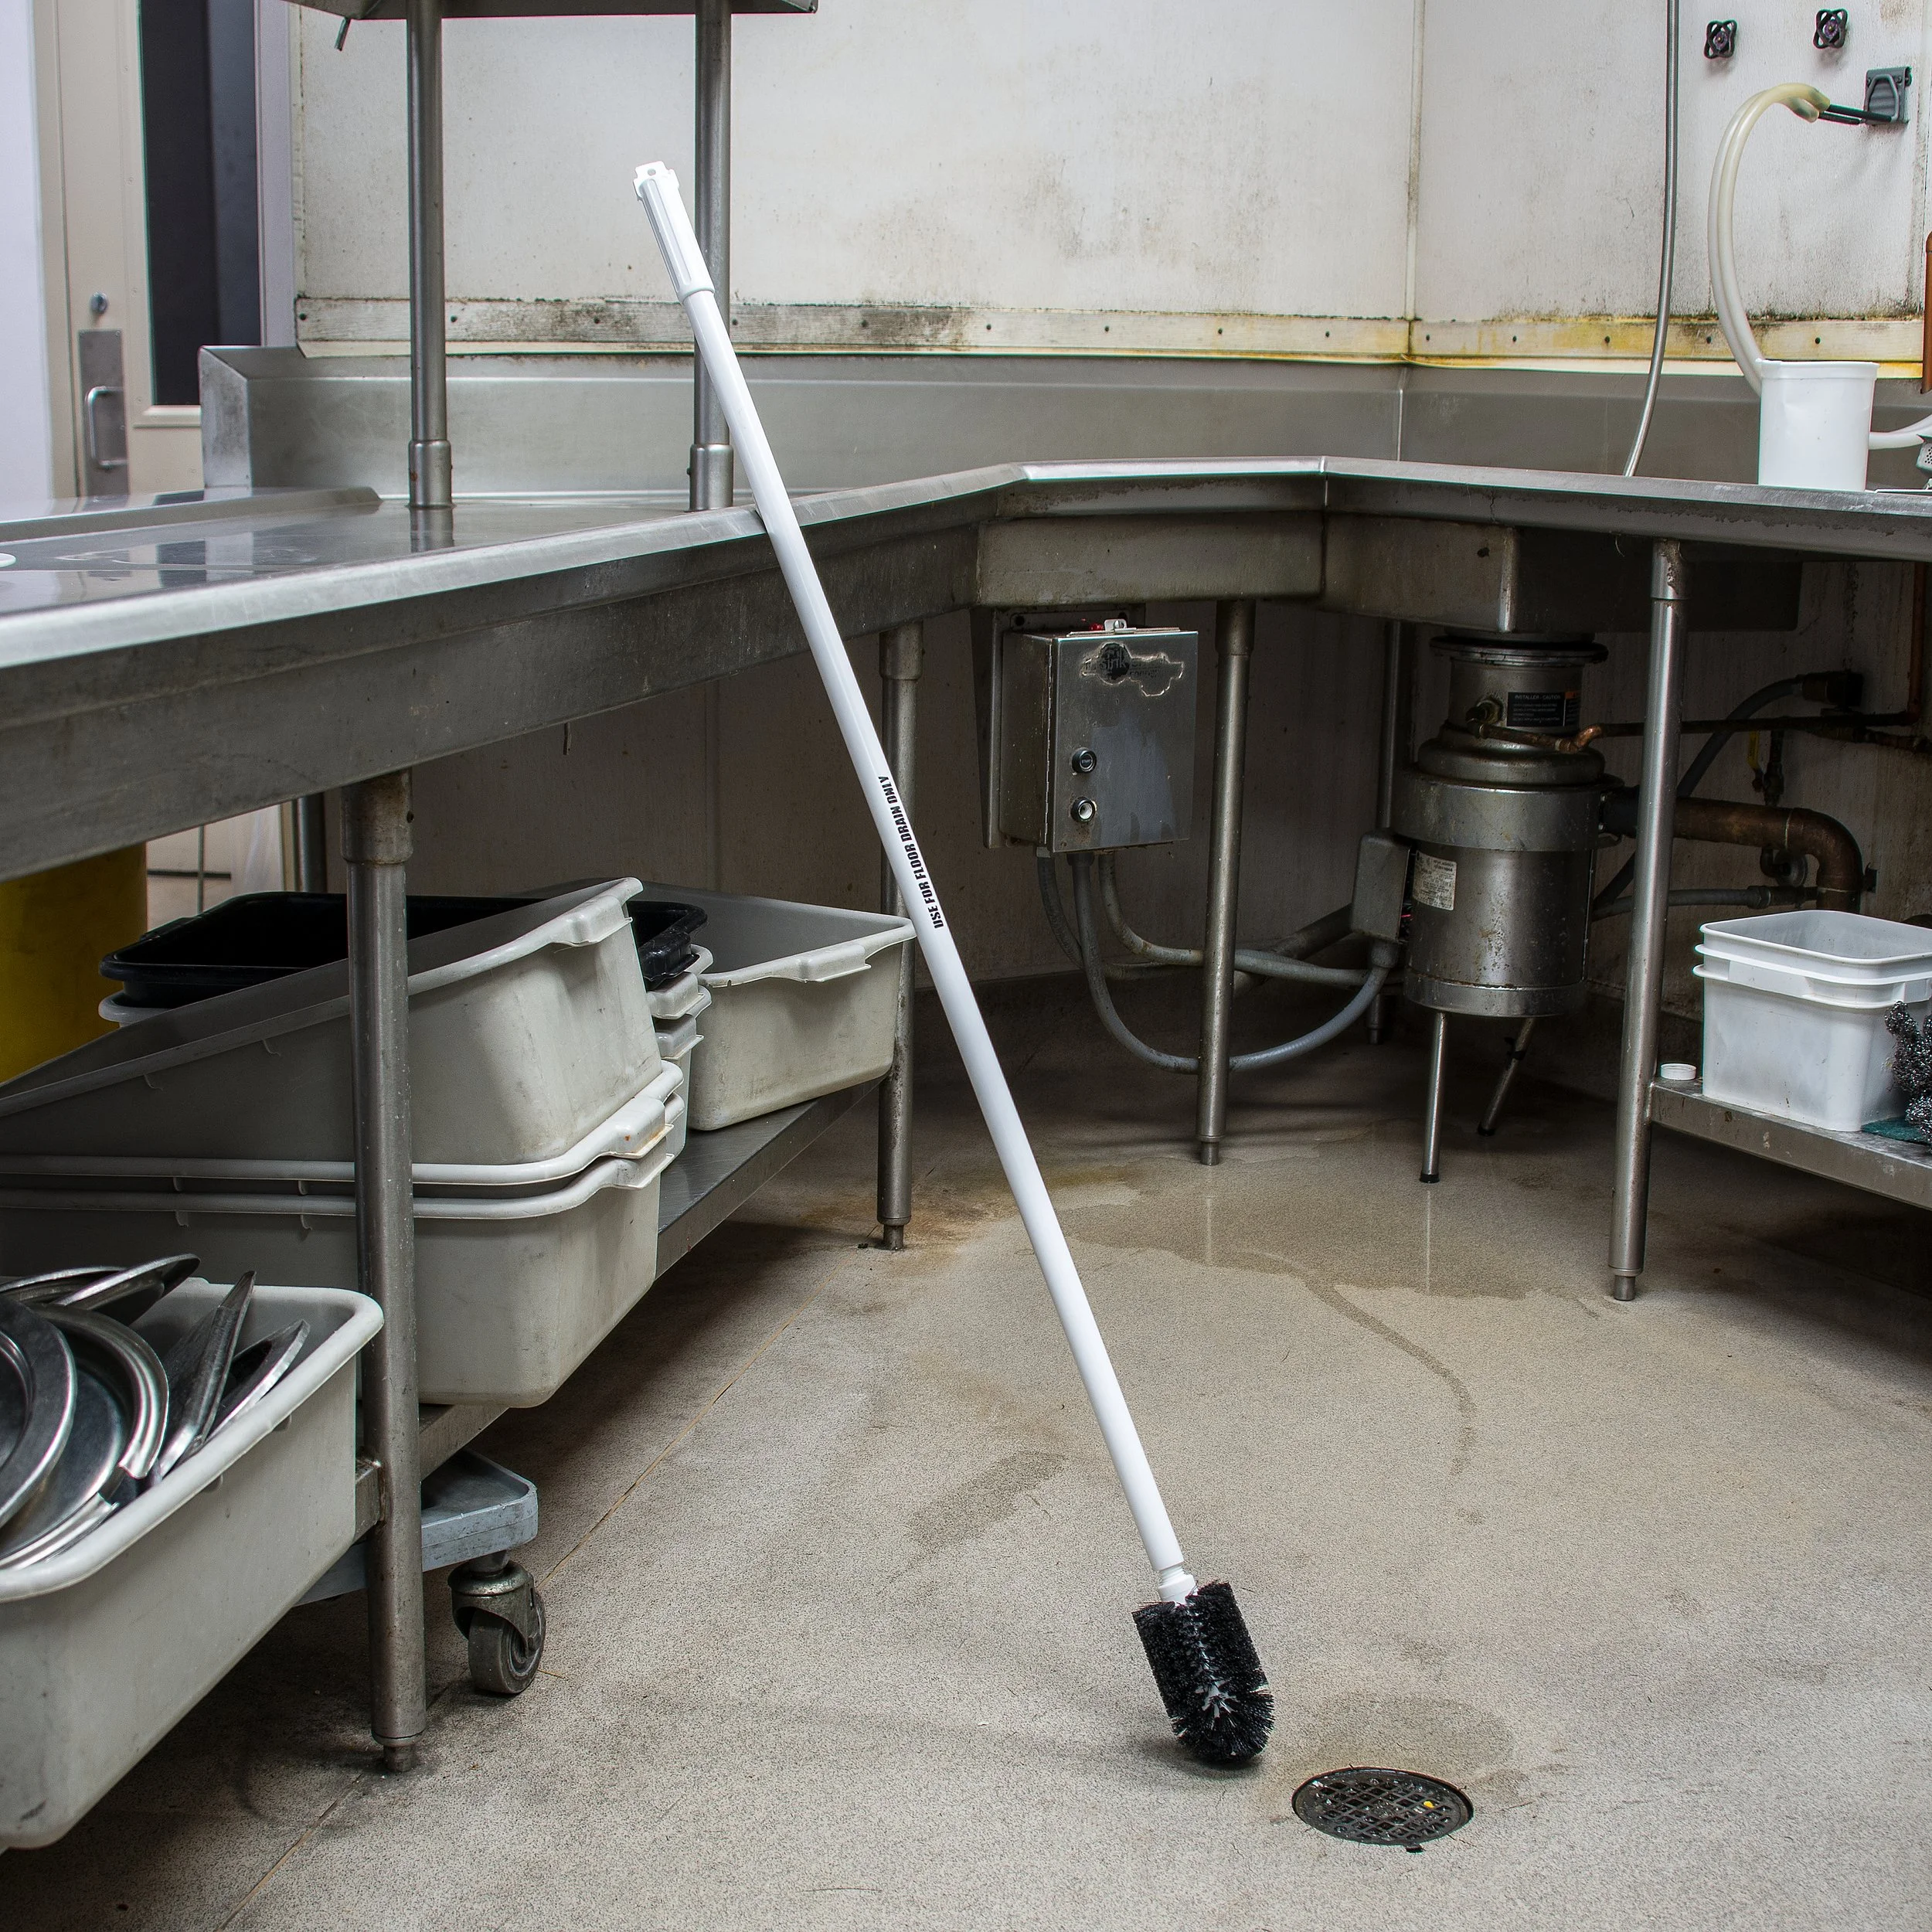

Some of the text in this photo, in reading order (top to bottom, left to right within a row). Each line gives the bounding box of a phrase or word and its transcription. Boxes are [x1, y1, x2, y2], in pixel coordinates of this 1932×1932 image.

[878, 776, 944, 929] USE FOR FLOOR DRAIN ONLY
